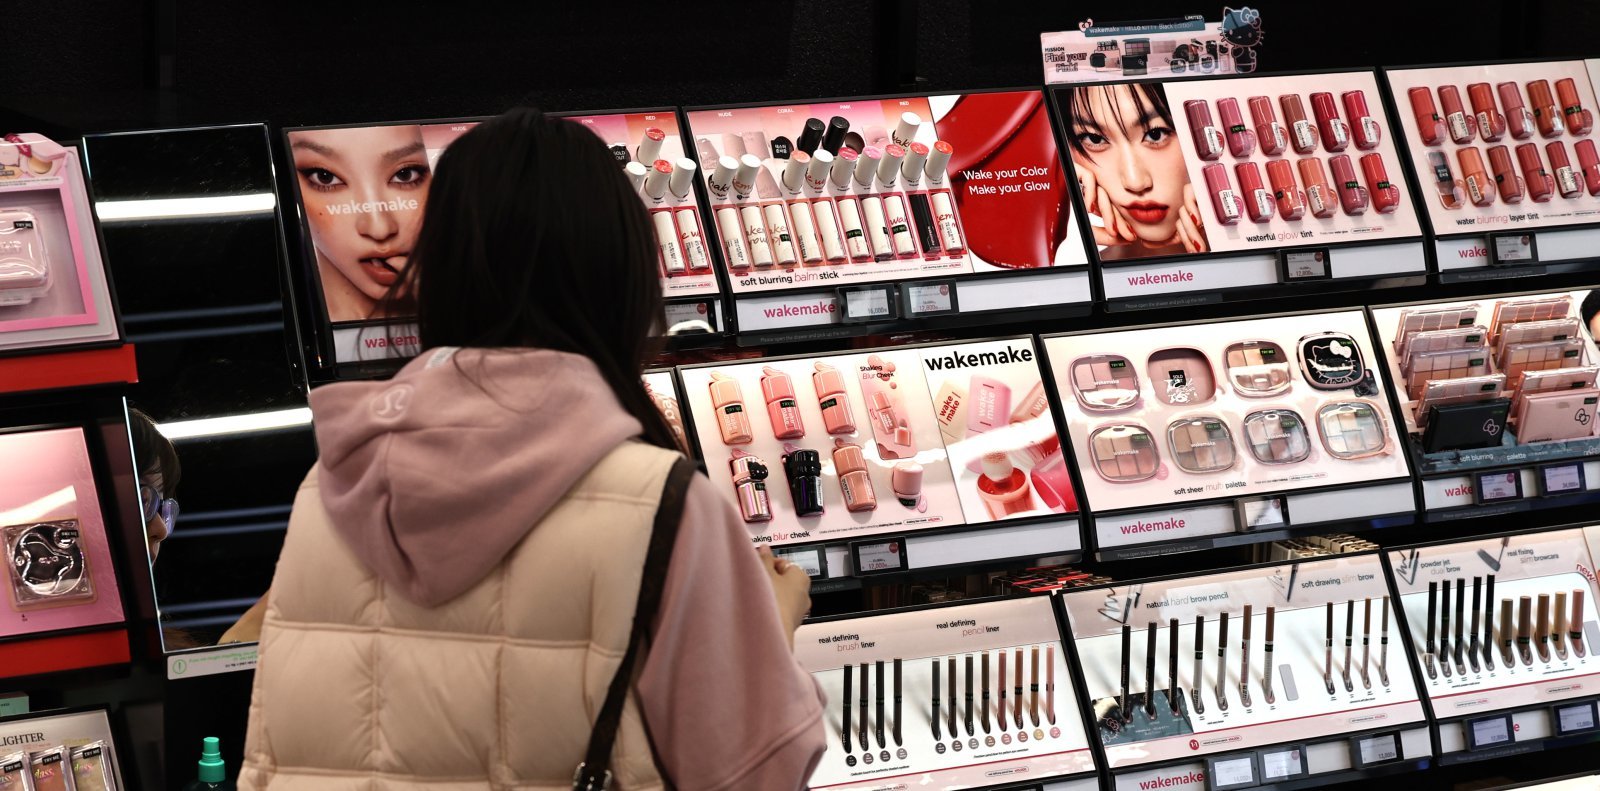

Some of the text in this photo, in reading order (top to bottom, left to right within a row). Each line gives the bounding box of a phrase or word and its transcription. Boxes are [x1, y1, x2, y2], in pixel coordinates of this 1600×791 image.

[1090, 26, 1120, 34] wakemake
[1045, 52, 1087, 63] Find your
[963, 166, 1048, 181] Wake your Color
[969, 181, 1050, 195] Make your Glow
[326, 196, 418, 215] wakemake
[1456, 212, 1540, 226] water blurring layer tint
[1246, 232, 1276, 243] waterful
[1278, 232, 1299, 242] glow
[1300, 230, 1314, 238] tint
[1458, 246, 1488, 258] wake
[740, 277, 757, 287] soft
[758, 276, 793, 286] blurring
[794, 272, 818, 283] balm
[819, 271, 840, 280] stick
[1128, 270, 1194, 286] wakemake
[764, 302, 836, 318] wakemake
[925, 346, 1033, 371] wakemake
[860, 364, 883, 374] Shaking
[862, 371, 895, 380] Blur Cheek
[939, 395, 954, 418] wake
[978, 388, 987, 417] wake
[987, 392, 996, 420] make
[946, 400, 960, 422] make
[1472, 454, 1494, 462] blurring
[1506, 453, 1527, 461] palette
[1174, 488, 1187, 496] soft
[1188, 486, 1204, 494] sheer
[1225, 480, 1247, 490] palette
[1445, 484, 1473, 497] wake
[1120, 518, 1185, 535] wakemake
[752, 530, 811, 543] aking blur cheek
[1421, 559, 1450, 569] powder jet
[1534, 553, 1559, 562] browcara
[1302, 580, 1315, 589] soft
[1315, 578, 1341, 587] drawing
[1358, 573, 1375, 581] brow
[1146, 592, 1229, 609] natural hard brow pencil
[936, 618, 976, 630] real defining
[818, 632, 860, 645] real defining
[962, 625, 1000, 638] pencil liner
[837, 640, 875, 652] brush liner
[0, 732, 45, 747] IGHTER
[1139, 772, 1205, 791] wakemake
